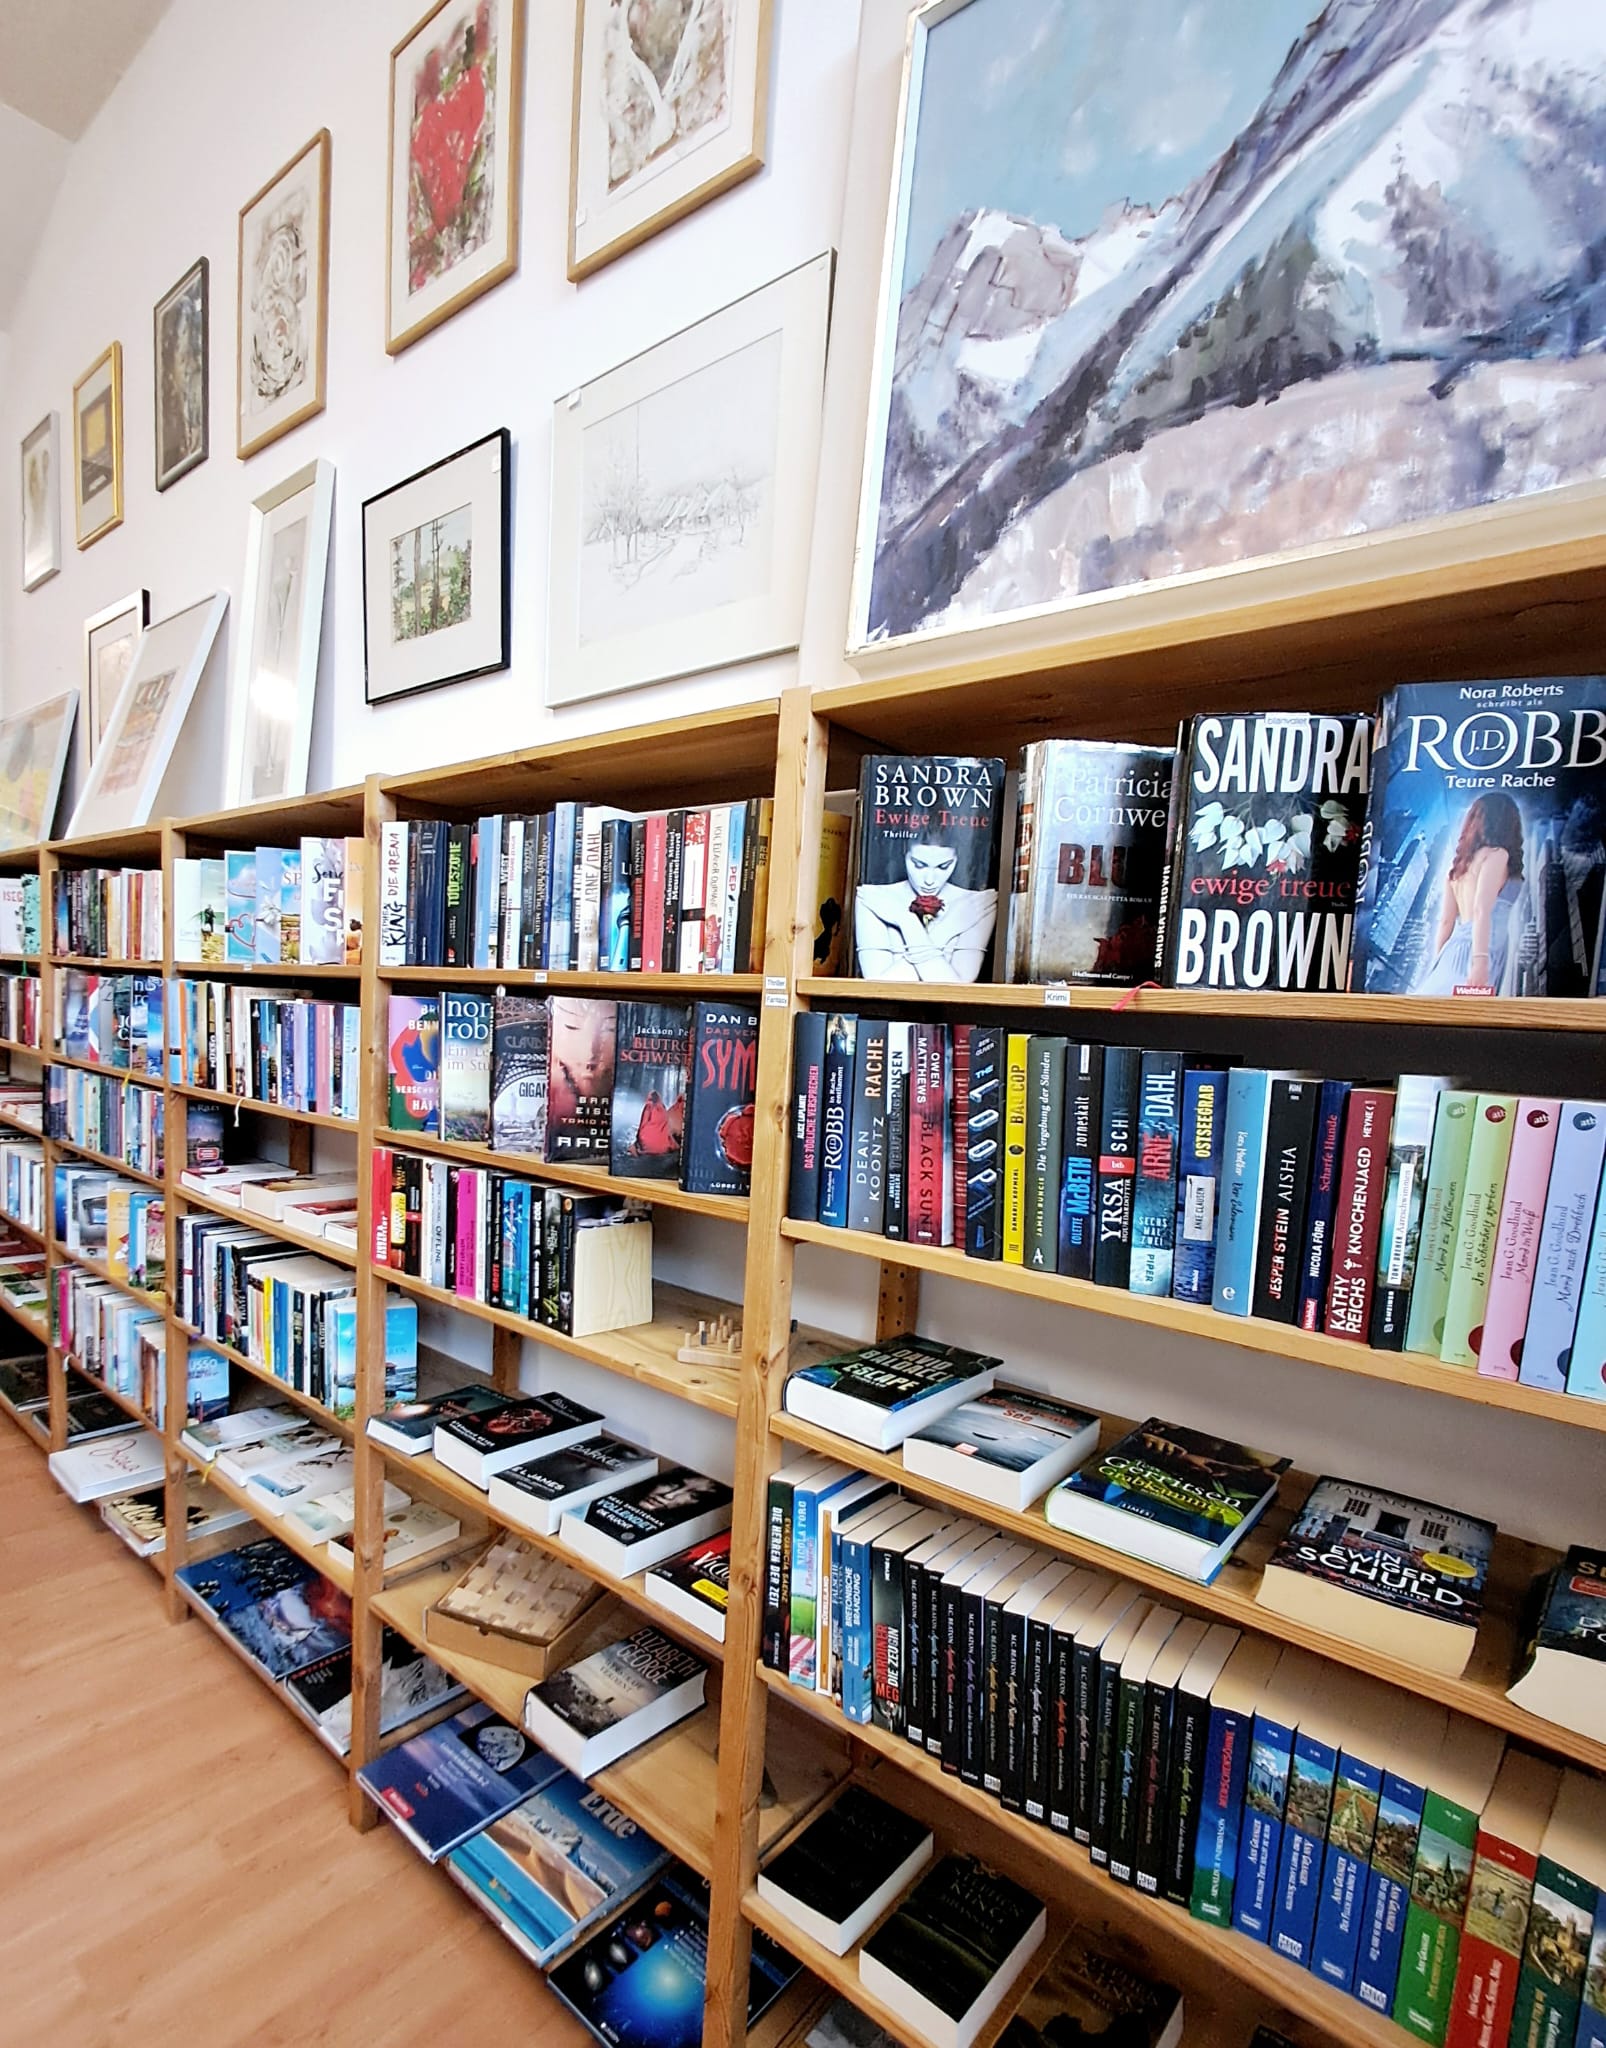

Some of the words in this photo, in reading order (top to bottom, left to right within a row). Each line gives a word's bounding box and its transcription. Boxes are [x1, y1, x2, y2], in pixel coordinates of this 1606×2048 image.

[1460, 686, 1496, 699] Nora
[1501, 684, 1563, 697] Roberts
[1477, 700, 1524, 708] schreibt
[1528, 698, 1543, 706] als
[1193, 718, 1369, 794] SANDRA
[1403, 710, 1606, 772] ROBB
[1467, 730, 1505, 755] J.D.
[876, 765, 992, 786] SANDRA
[1070, 770, 1173, 799] Patricia
[1446, 775, 1494, 789] Teure
[1500, 774, 1555, 787] Rache
[875, 786, 992, 808] BROWN
[1055, 797, 1166, 827] Cornwe
[875, 810, 929, 827] Ewige
[939, 811, 989, 827] Treue
[388, 832, 400, 873] ARENA
[667, 829, 676, 858] Mistel,
[446, 841, 461, 907] TODESZONE
[673, 832, 682, 900] Meuchelmord
[729, 866, 737, 892] PEP
[388, 877, 398, 896] DIE
[1159, 865, 1170, 915] BROWN
[1191, 876, 1270, 905] ewige
[1280, 877, 1351, 897] treue
[388, 901, 406, 947] KING
[1154, 917, 1165, 968] SANDRA
[1176, 909, 1352, 991] BROWN
[1047, 993, 1067, 1001] Krimi
[1456, 987, 1492, 996] Weltbild
[447, 1000, 491, 1017] nor
[706, 1014, 741, 1024] DAN
[447, 1018, 489, 1039] rob
[636, 1026, 673, 1035] Jackson
[706, 1027, 729, 1035] DAS
[447, 1045, 469, 1056] Ein
[447, 1059, 464, 1070] im
[865, 1039, 883, 1097] RACHE
[917, 1038, 927, 1103] MATTHEWS
[930, 1052, 940, 1088] OWEN
[974, 1065, 993, 1078] THE
[1011, 1065, 1025, 1091] COP
[1040, 1052, 1050, 1085] Sünden
[806, 1066, 818, 1117] VERSPRECHEN
[836, 1066, 844, 1103] entflammt
[1040, 1088, 1049, 1103] der
[1145, 1070, 1176, 1117] DAHL
[561, 1117, 597, 1125] TOKIO
[797, 1124, 805, 1139] ALICE
[805, 1120, 816, 1152] TÖDLICHE
[1038, 1106, 1050, 1151] Vergebung
[1074, 1097, 1089, 1147] zorneskalt
[1195, 1085, 1214, 1158] OSTSEEGRAB
[1323, 1114, 1338, 1153] Hunde
[1363, 1111, 1376, 1138] HEYNE
[824, 1108, 844, 1170] ROBB
[920, 1120, 934, 1181] BLACK
[804, 1154, 814, 1168] DAS
[857, 1131, 869, 1184] DEAN
[869, 1117, 884, 1200] KOONTZ
[1037, 1155, 1047, 1171] Die
[1142, 1132, 1173, 1182] ARNE
[1066, 1157, 1092, 1214] McBETH
[1280, 1147, 1297, 1202] AISHA
[1319, 1155, 1336, 1192] Scharfe
[920, 1189, 932, 1225] SUN
[1101, 1178, 1123, 1241] YRSA
[1195, 1187, 1205, 1213] CLAUSEN
[1347, 1147, 1372, 1255] KNOCHENJAGD
[1465, 1193, 1482, 1237] Goodhind
[1071, 1218, 1083, 1244] COLETTE
[1194, 1215, 1202, 1229] ANKE
[1273, 1209, 1289, 1251] STEIN
[1314, 1220, 1325, 1244] FÖRG
[1505, 1201, 1522, 1246] Goodhind
[1550, 1205, 1568, 1252] Goodhind
[1568, 1193, 1587, 1243] Drehbuch
[1145, 1253, 1154, 1282] PIPER
[1310, 1247, 1322, 1278] NICOLA
[1391, 1264, 1400, 1279] TONY
[1461, 1252, 1472, 1270] Jean
[1500, 1261, 1514, 1280] Jean
[1516, 1248, 1530, 1282] Mord
[1565, 1249, 1577, 1271] nach
[1268, 1253, 1285, 1299] JESPER
[1544, 1267, 1557, 1286] Jean
[1330, 1274, 1350, 1330] KATHY
[1346, 1277, 1366, 1333] REICHS
[1557, 1275, 1573, 1312] Mord
[190, 1358, 218, 1368] USSO
[859, 1349, 954, 1383] BALDACCI
[893, 1348, 953, 1372] DAVID
[842, 1362, 920, 1391] ESCAPE
[1002, 1409, 1033, 1423] See
[528, 1472, 565, 1491] JAMES
[1105, 1456, 1241, 1508] Gerritsen
[597, 1499, 658, 1532] VOLLENDET
[772, 1507, 783, 1522] DIE
[770, 1525, 782, 1563] HERREN
[1374, 1550, 1401, 1566] IN
[770, 1565, 780, 1585] DER
[1296, 1546, 1464, 1606] SCHULD
[1330, 1545, 1437, 1585] EWIGER
[769, 1587, 779, 1608] ZEIT
[845, 1567, 853, 1627] BRETONISCHE
[629, 1628, 702, 1677] ELIZABETH
[875, 1624, 888, 1683] GARDINER
[887, 1627, 899, 1667] ZEUGIN
[617, 1644, 676, 1684] GEORGE
[887, 1670, 898, 1687] DIE
[876, 1682, 900, 1702] MEG
[1186, 1716, 1194, 1731] M.C.
[1184, 1732, 1192, 1762] BEATON
[578, 1790, 638, 1839] Erde
